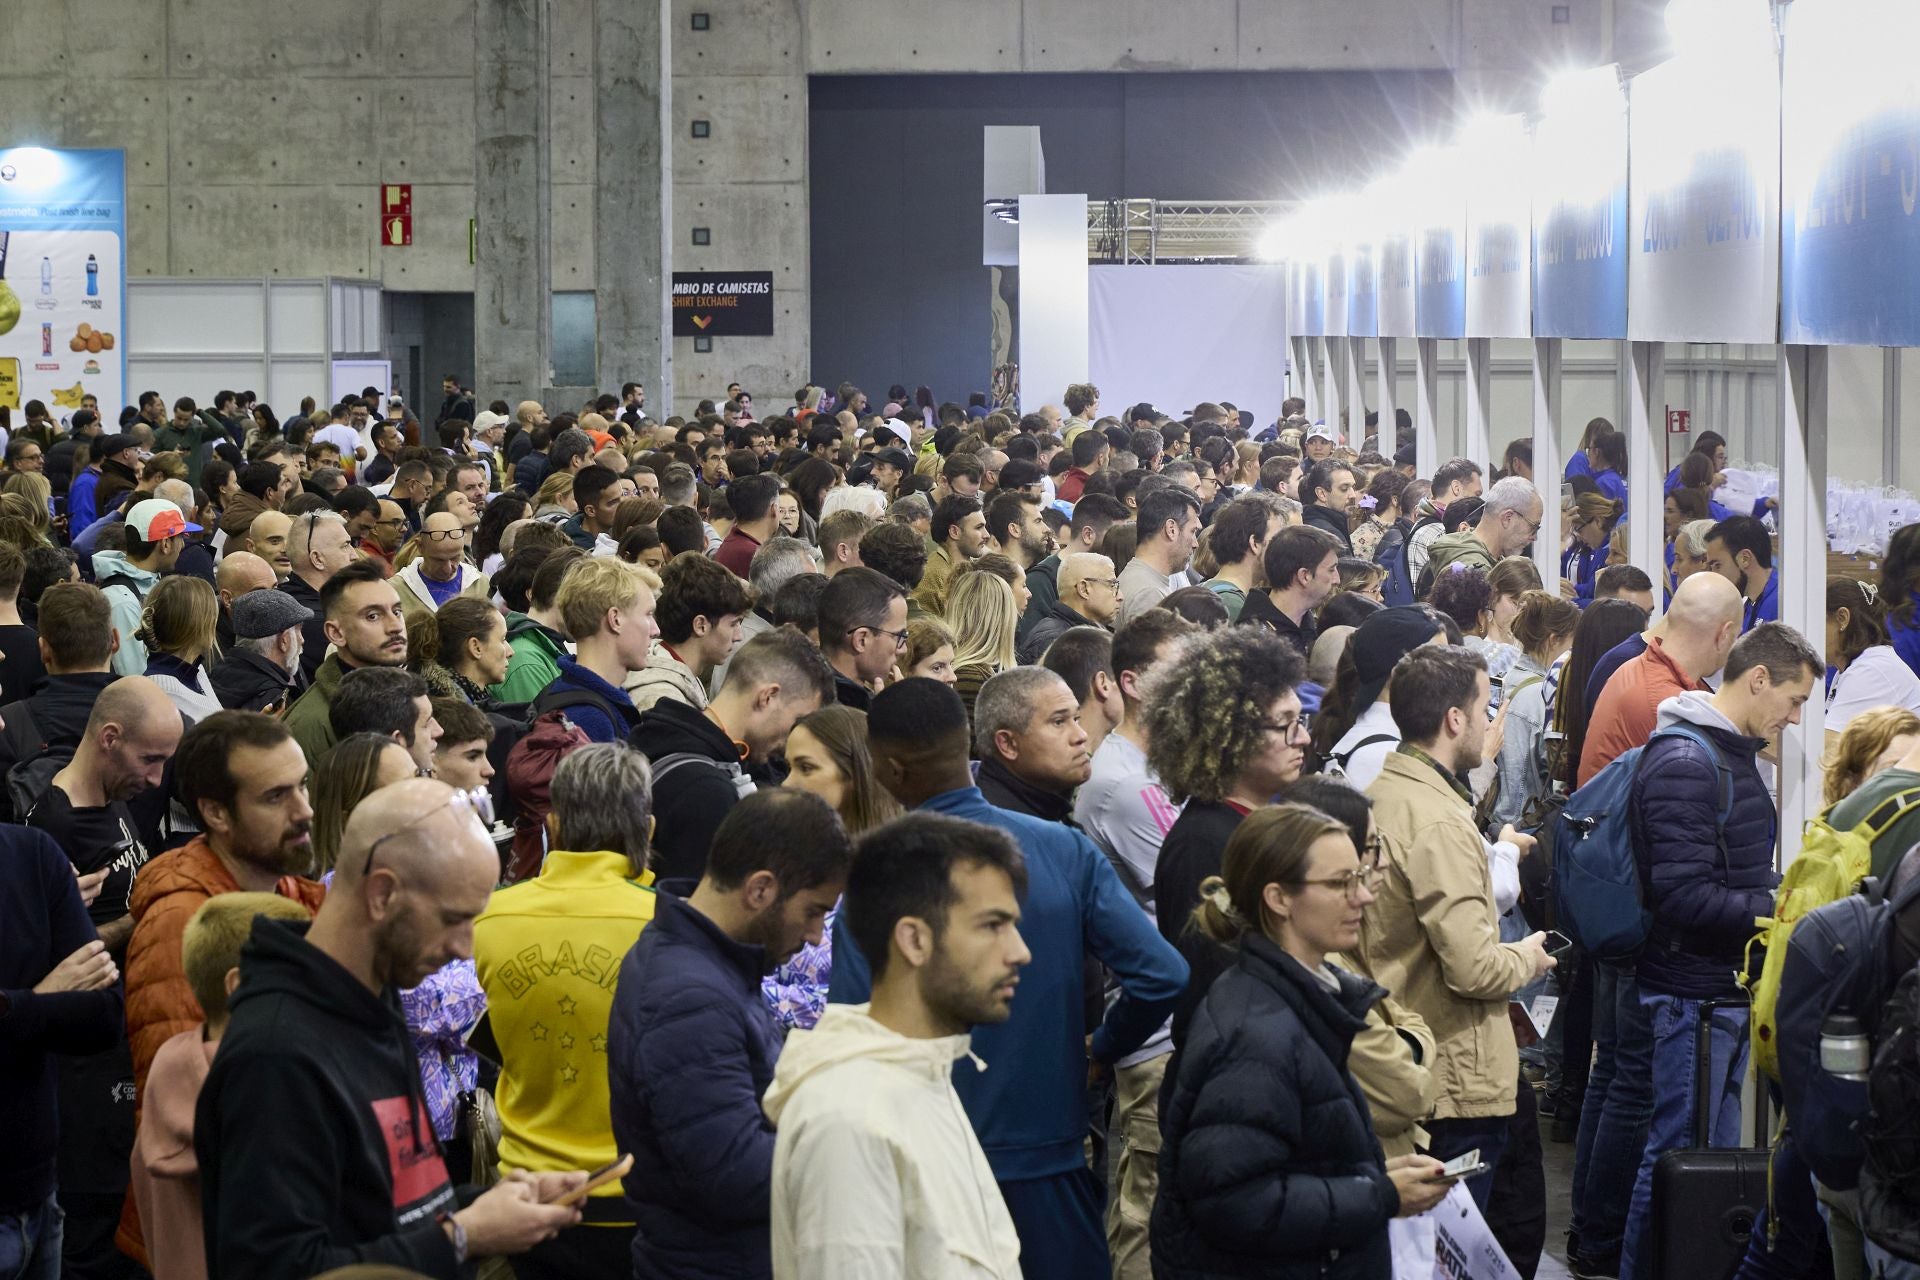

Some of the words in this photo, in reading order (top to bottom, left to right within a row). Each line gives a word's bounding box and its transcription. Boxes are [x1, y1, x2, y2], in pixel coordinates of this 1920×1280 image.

[96, 207, 111, 218] bag
[702, 282, 714, 294] DE
[716, 282, 770, 294] CAMISETAS
[696, 296, 738, 307] EXCHANGE
